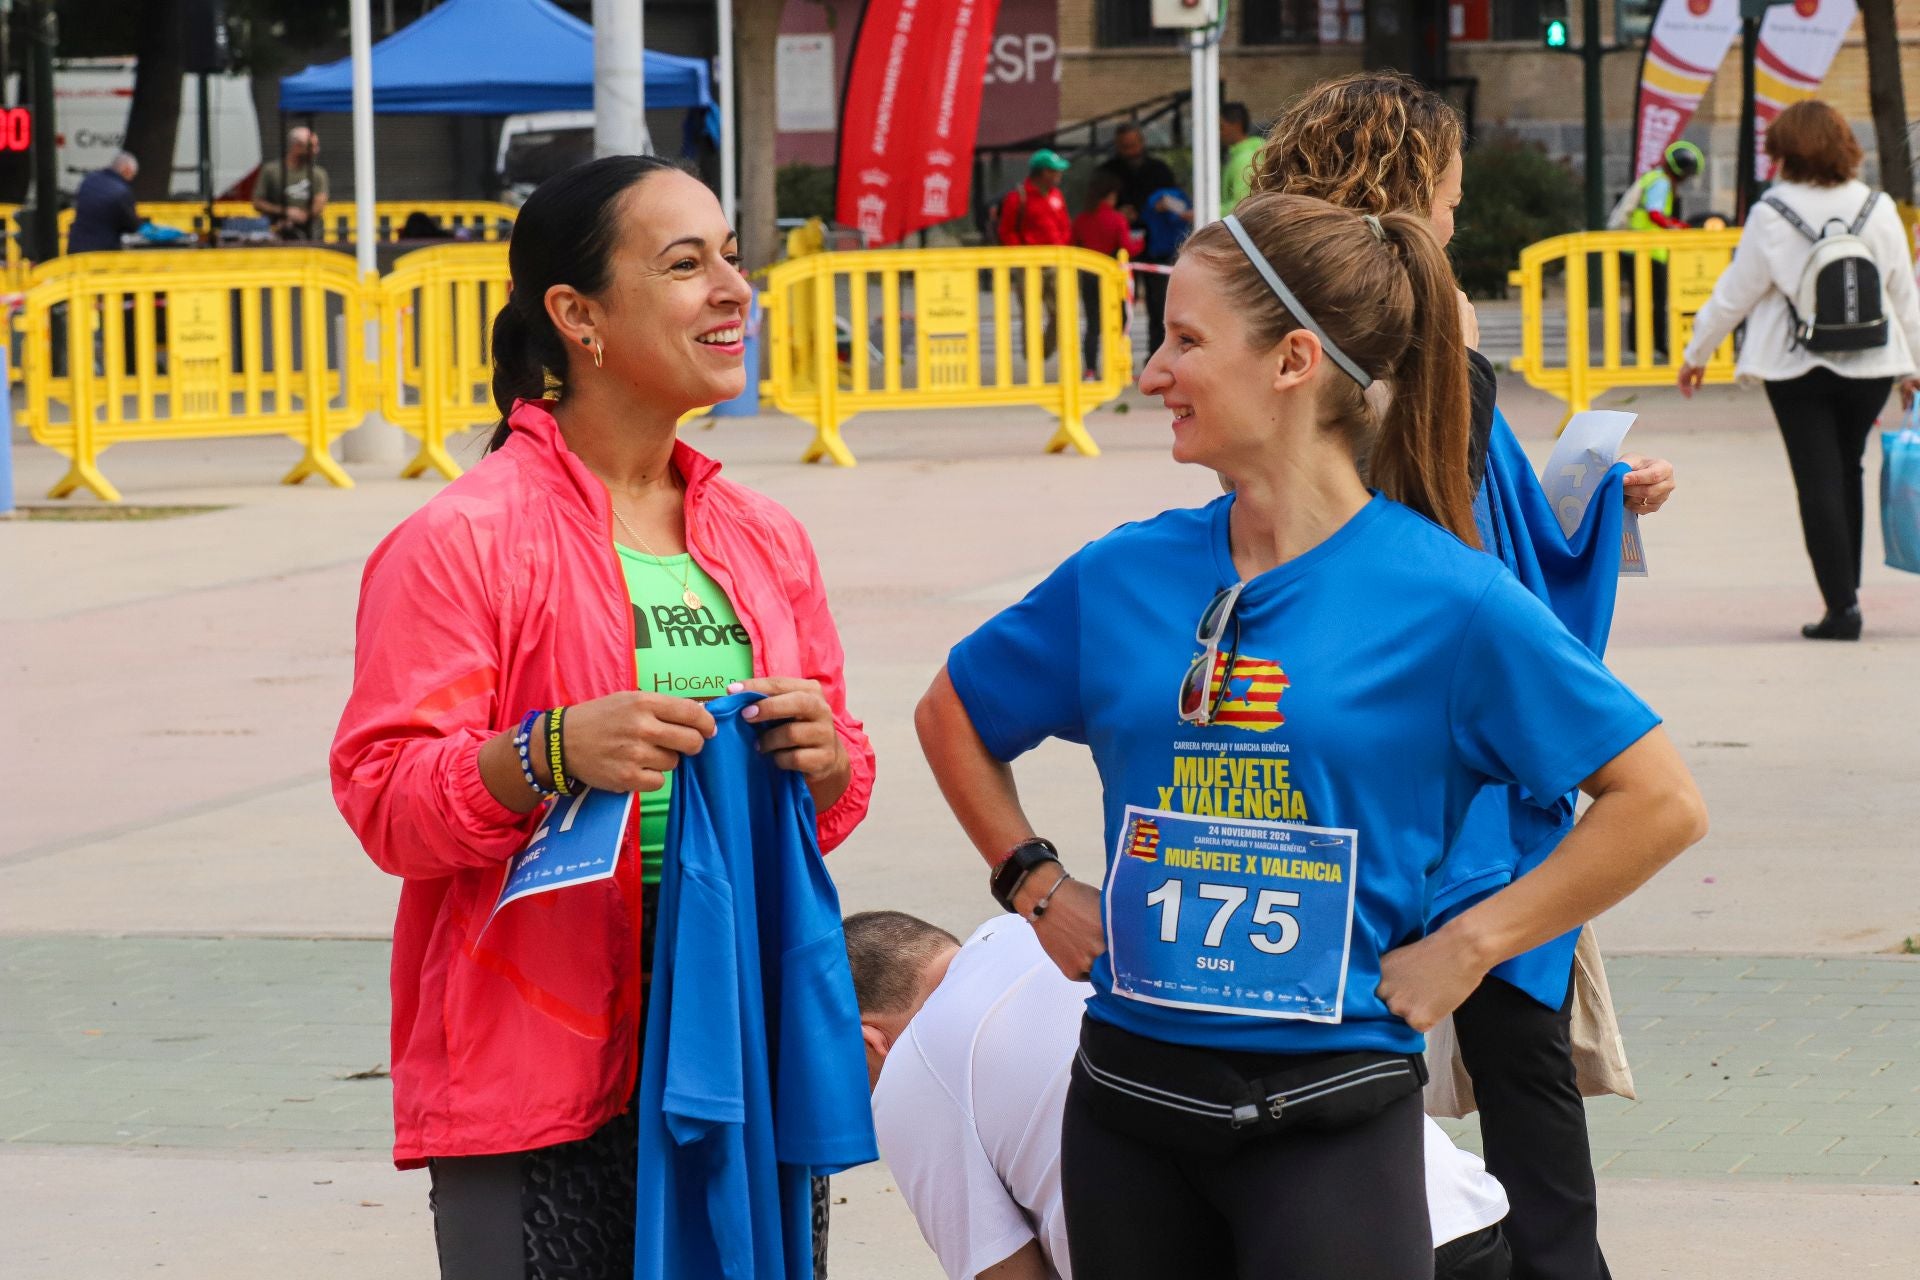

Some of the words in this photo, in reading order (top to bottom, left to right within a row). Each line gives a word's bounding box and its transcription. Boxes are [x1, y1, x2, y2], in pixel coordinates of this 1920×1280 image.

[650, 605, 716, 632] pan
[664, 623, 751, 647] more
[1173, 740, 1201, 751] CARRERA
[1201, 742, 1228, 752] POPULAR
[1228, 743, 1234, 752] Y
[1233, 743, 1261, 753] MARCHA
[1261, 741, 1290, 753] BENÉFICA
[1173, 752, 1291, 790] MUÉVETE
[1157, 786, 1175, 812] X
[1181, 787, 1309, 821] VALENCIA
[1193, 836, 1221, 846] CARRERA
[1221, 838, 1248, 848] POPULAR
[1248, 840, 1254, 849] Y
[1254, 840, 1279, 850] MARCHA
[1208, 825, 1219, 835] 24
[1221, 827, 1268, 840] NOVIEMBRE
[1270, 830, 1291, 842] 2024
[1164, 847, 1241, 874] MUÉVETE
[1244, 855, 1257, 875] X
[1261, 857, 1342, 883] VALENCIA
[1146, 878, 1301, 955] 175
[1196, 956, 1235, 972] SUSI
